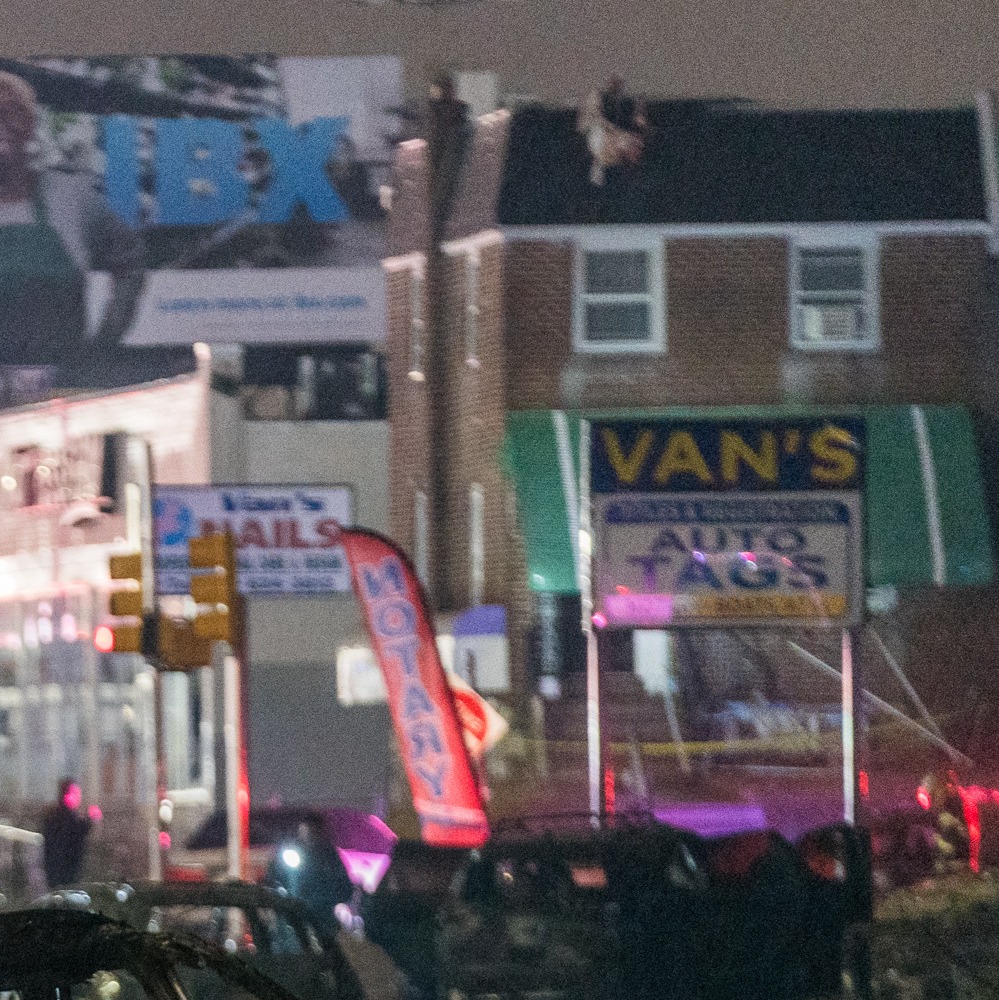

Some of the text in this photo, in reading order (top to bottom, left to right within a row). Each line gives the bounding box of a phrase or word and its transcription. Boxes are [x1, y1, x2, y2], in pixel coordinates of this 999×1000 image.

[602, 423, 860, 485] VAN'S
[650, 527, 809, 554] AUTO
[628, 554, 830, 590] TAGS
[359, 558, 446, 797] NOTARY
